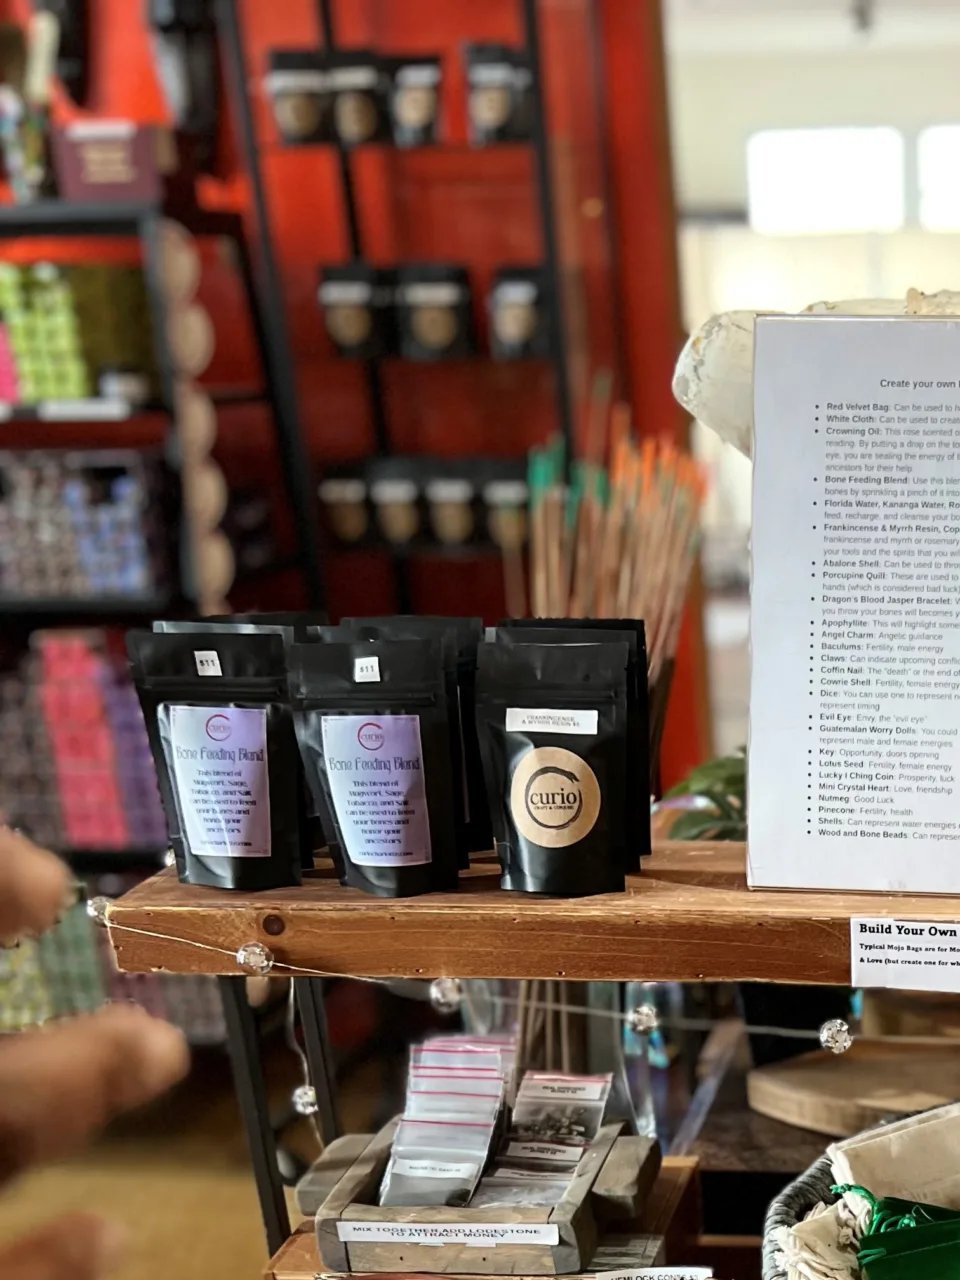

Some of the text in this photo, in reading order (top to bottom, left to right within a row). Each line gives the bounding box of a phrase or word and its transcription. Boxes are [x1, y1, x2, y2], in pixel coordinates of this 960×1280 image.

[879, 378, 910, 388] Create
[913, 381, 933, 390] your
[821, 630, 845, 640] Angel
[878, 631, 906, 642] Angelic
[908, 632, 943, 642] guidance
[199, 659, 216, 668] $11
[359, 665, 375, 673] $11
[329, 757, 421, 774] Bone Feeding Blend
[818, 782, 835, 790] Mini
[837, 783, 865, 792] Crystal
[916, 785, 953, 796] friendship
[530, 788, 577, 805] curio
[854, 795, 875, 803] Good
[890, 807, 913, 816] health
[859, 923, 892, 934] Build
[895, 925, 925, 936] Your
[928, 926, 957, 937] Own
[859, 942, 885, 950] Typical
[887, 944, 904, 952] Mojo
